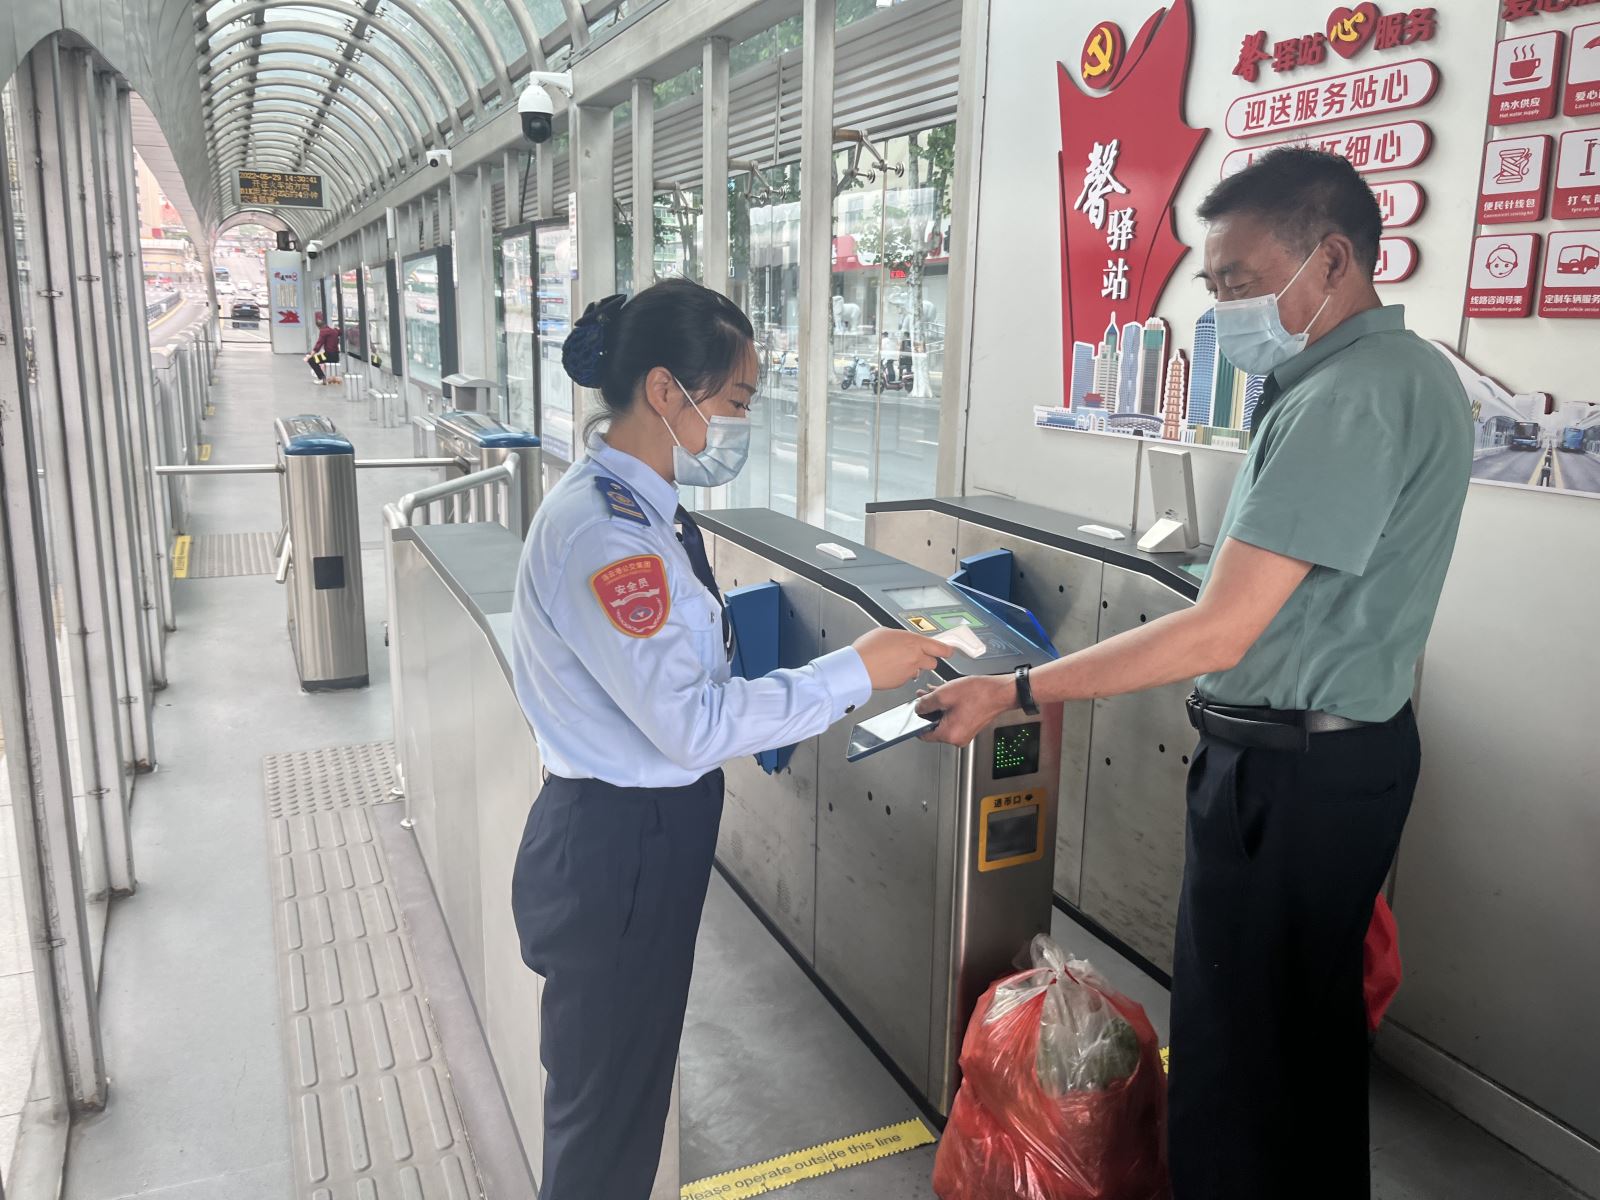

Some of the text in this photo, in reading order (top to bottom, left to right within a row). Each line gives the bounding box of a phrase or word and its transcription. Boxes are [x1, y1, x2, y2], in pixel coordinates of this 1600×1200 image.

[1243, 69, 1408, 131] 迎送服务贴心
[1500, 97, 1540, 111] 热水供应
[1484, 198, 1535, 211] 便民针线包
[1074, 139, 1134, 300] 馨驿站
[1544, 294, 1600, 304] 定制车辆服务
[614, 577, 650, 596] 安全员
[735, 1166, 796, 1191] operate
[796, 1149, 846, 1171] outside
[848, 1139, 874, 1155] this
[878, 1132, 902, 1148] line
